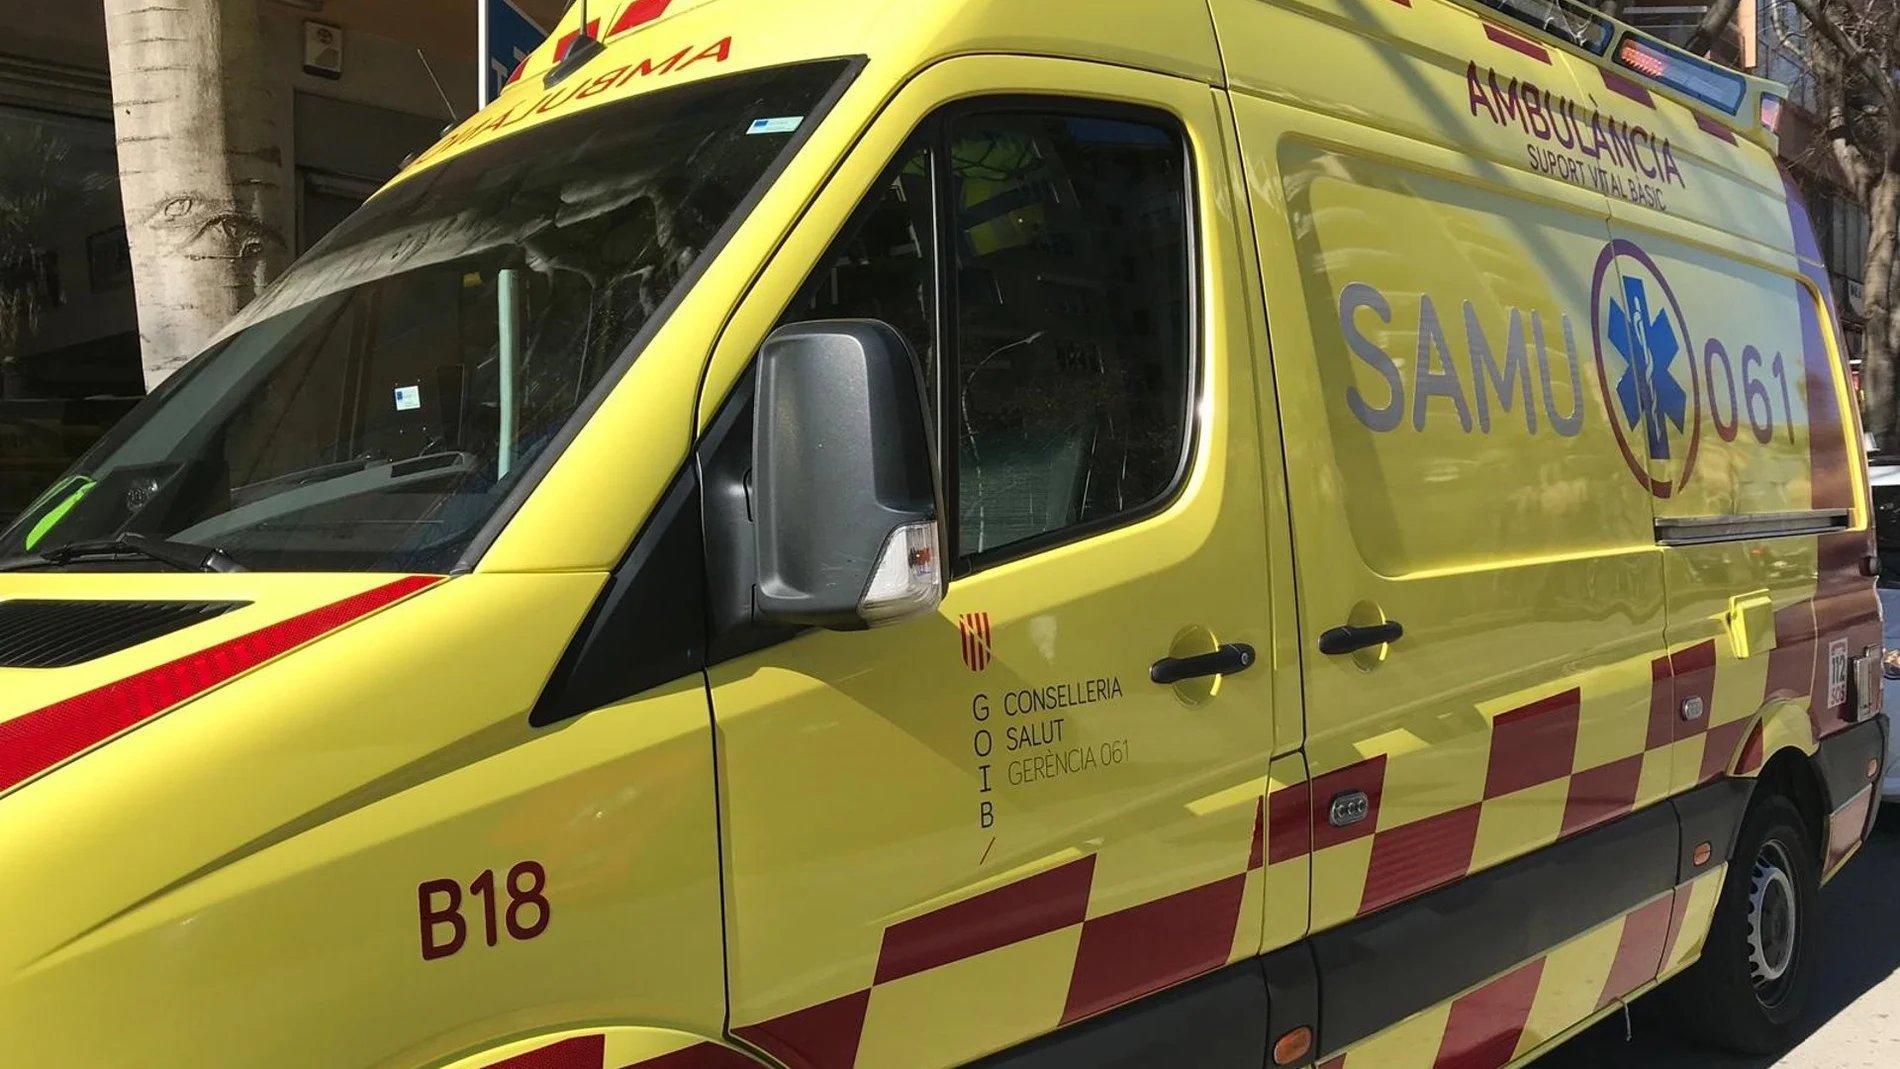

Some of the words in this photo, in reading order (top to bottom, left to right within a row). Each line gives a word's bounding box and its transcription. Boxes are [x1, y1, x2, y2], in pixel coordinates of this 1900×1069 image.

[1466, 59, 1687, 189] AMBULÀNCIA
[1526, 143, 1585, 185] SUPORT
[1588, 163, 1629, 200] VITAL
[1630, 175, 1667, 212] BÀSIC
[1338, 281, 1585, 438] SAMU
[1704, 336, 1796, 446] 061
[1003, 676, 1123, 717] CONSELLERIA
[1831, 655, 1845, 684] 112
[1006, 718, 1065, 751] SALUT
[1007, 746, 1097, 786] GERÈNCIA
[1100, 739, 1130, 766] 061
[418, 860, 551, 961] B18
